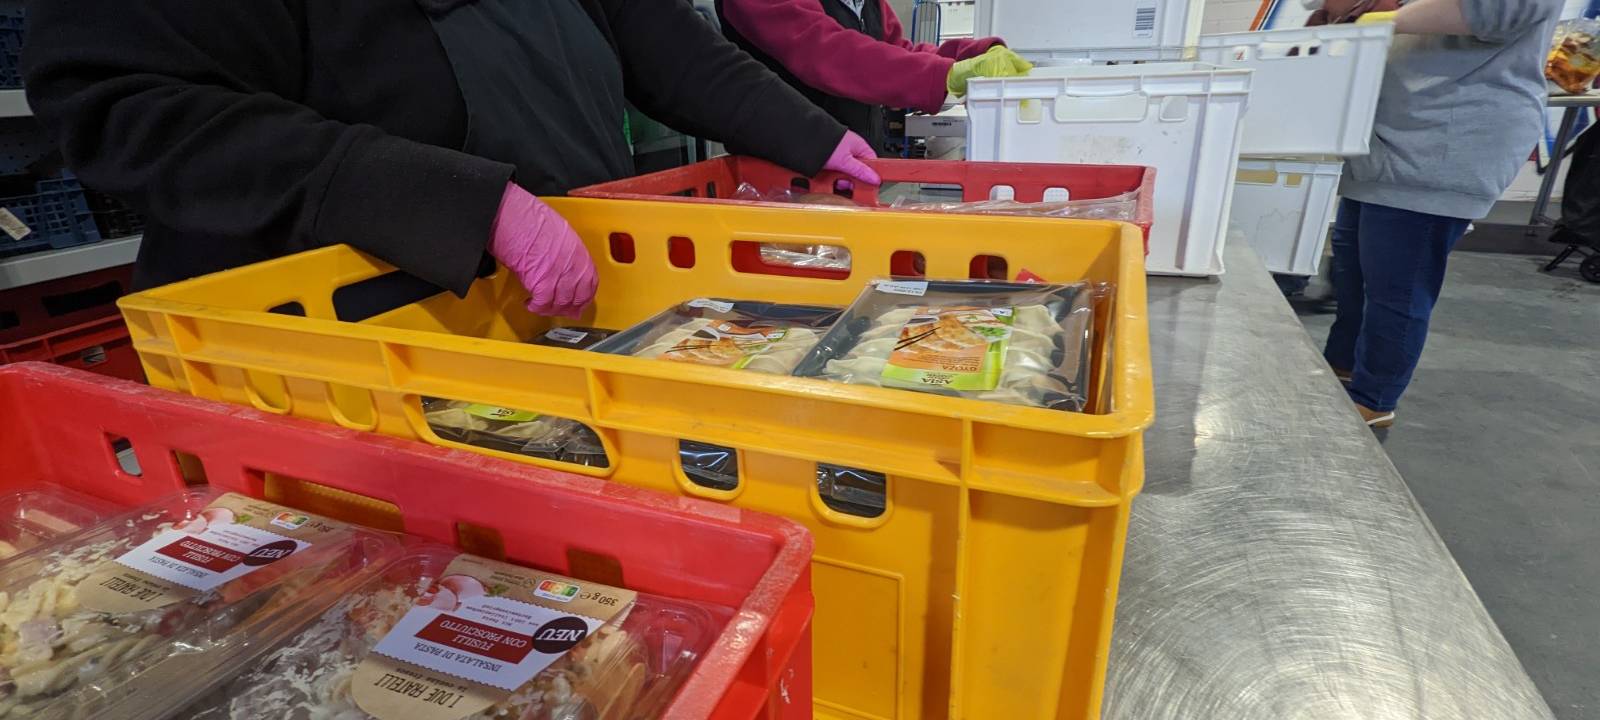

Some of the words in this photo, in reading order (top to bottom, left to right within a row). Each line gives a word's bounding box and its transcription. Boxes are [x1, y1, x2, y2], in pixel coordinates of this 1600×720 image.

[180, 541, 225, 557] PROSCIUTTO
[249, 548, 291, 559] NEU
[182, 551, 213, 563] FUSILLI
[221, 554, 240, 562] CON
[100, 577, 140, 595] FRATELLI
[591, 592, 601, 603] g
[597, 594, 619, 607] 350
[439, 619, 503, 642] PROSCIUTTO
[534, 628, 585, 642] NEU
[452, 634, 494, 651] FUSILLI
[502, 633, 528, 648] CON
[414, 642, 444, 658] PASTA
[441, 649, 453, 659] DI
[453, 652, 502, 672] INSALATA
[373, 673, 430, 698] FRATELLI
[424, 689, 454, 705] DUE
[448, 696, 464, 708] I
